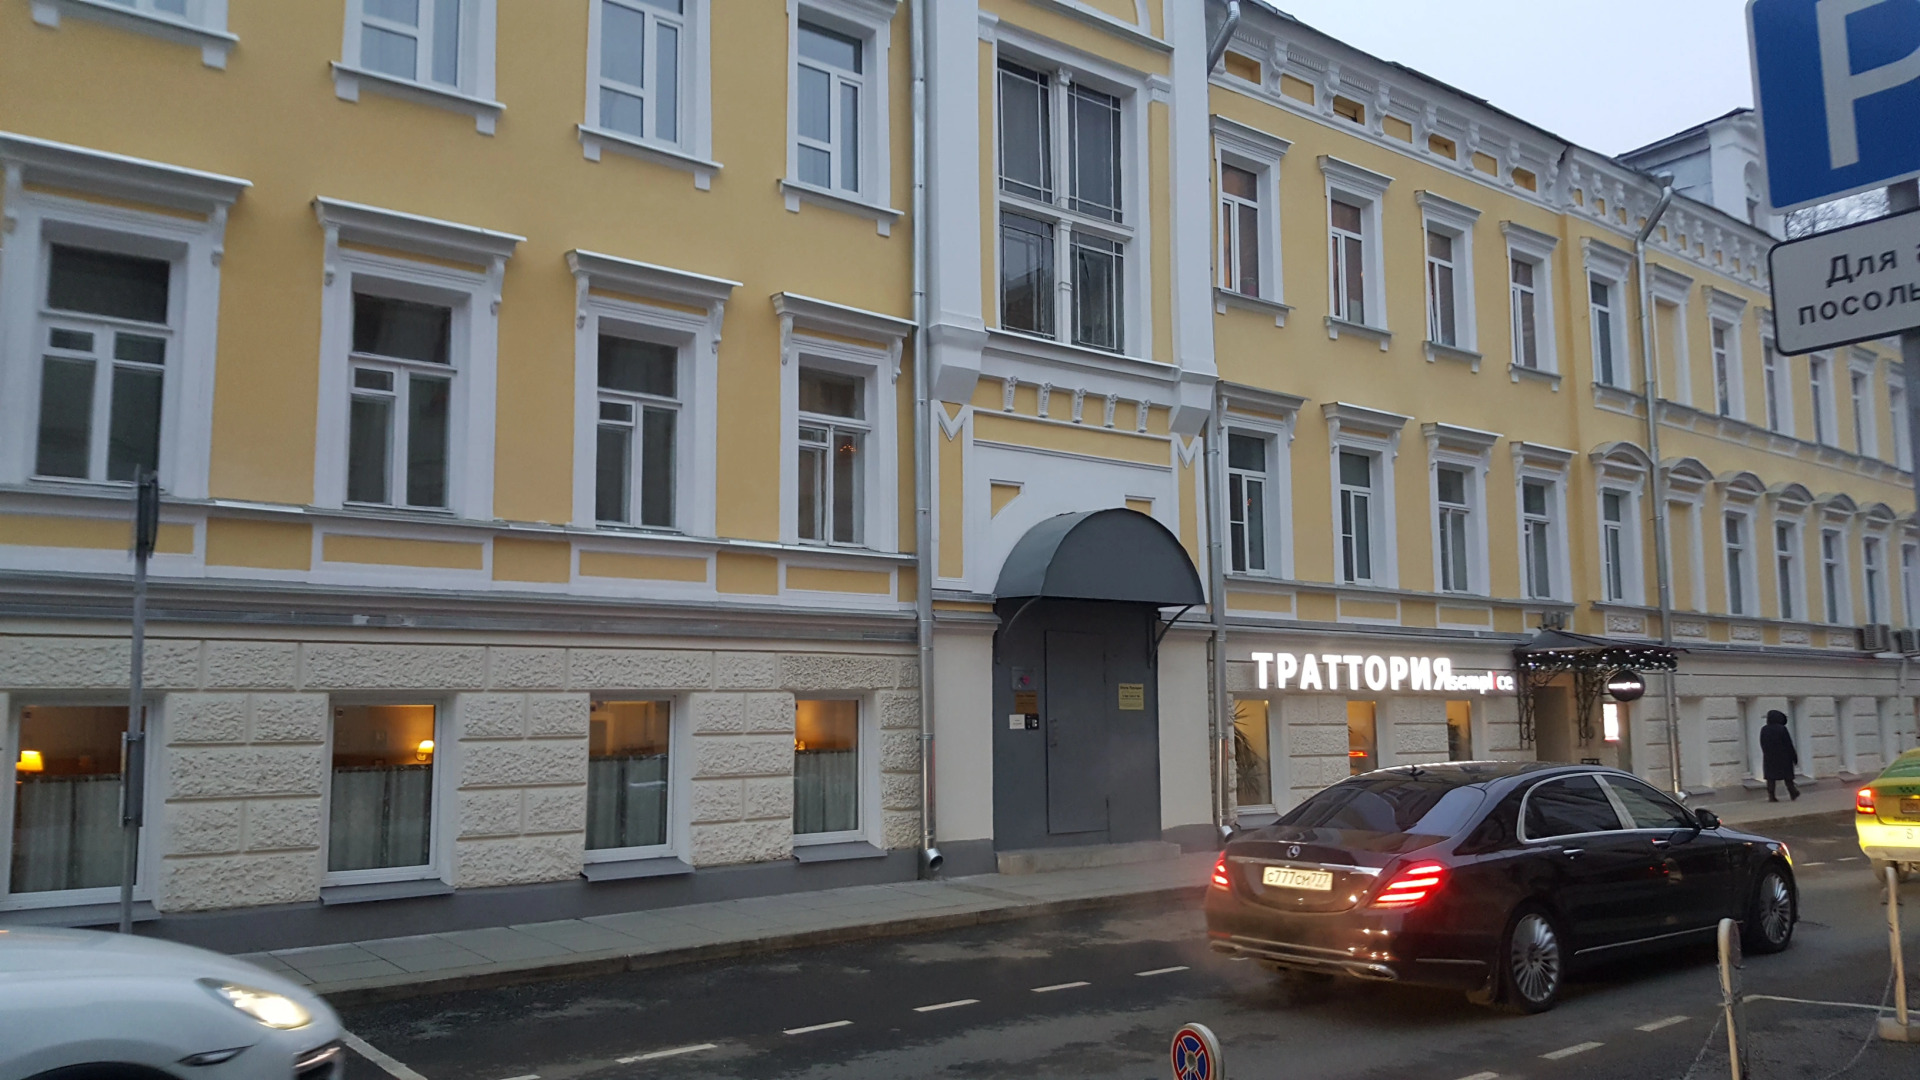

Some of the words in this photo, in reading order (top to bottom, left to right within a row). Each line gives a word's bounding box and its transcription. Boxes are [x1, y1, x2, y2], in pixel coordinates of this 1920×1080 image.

[1816, 0, 1920, 170] P
[1826, 249, 1897, 289] Для
[1798, 282, 1920, 326] посоль
[1251, 652, 1451, 691] ТРАТТОРИЯ
[1450, 670, 1514, 695] semplice
